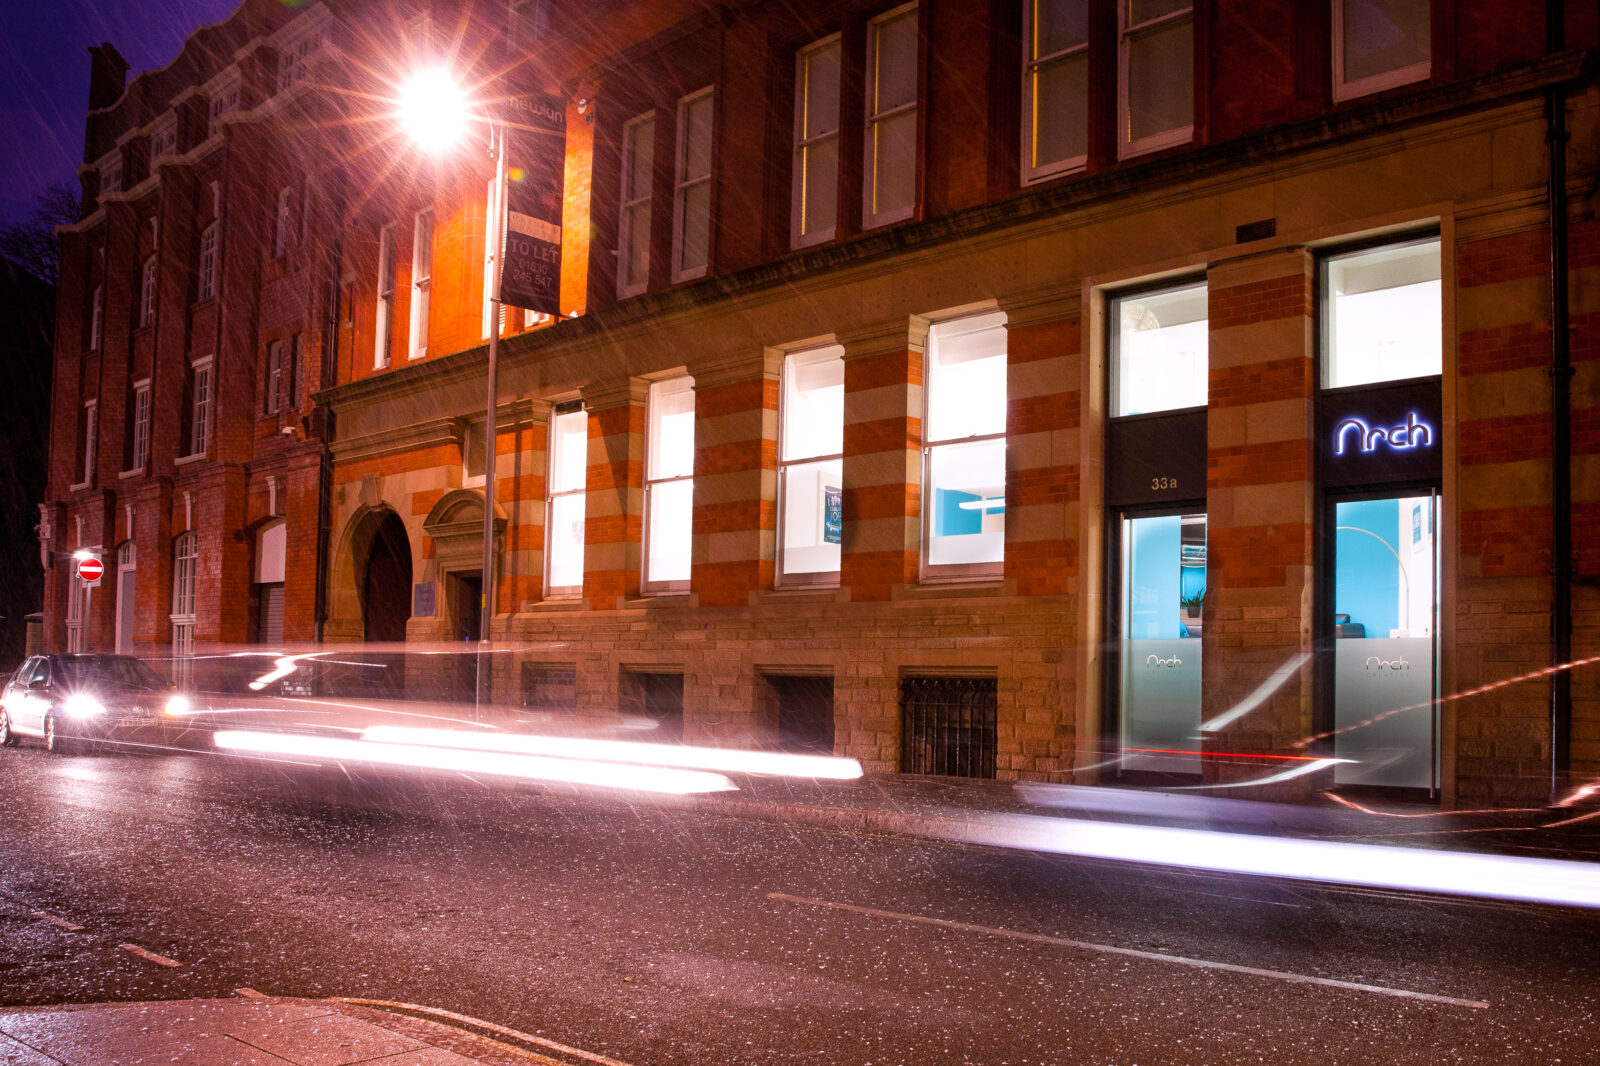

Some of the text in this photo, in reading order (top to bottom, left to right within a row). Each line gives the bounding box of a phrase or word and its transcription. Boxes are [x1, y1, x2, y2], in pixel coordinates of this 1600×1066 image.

[510, 238, 559, 264] TO LET
[1151, 477, 1178, 490] 33a
